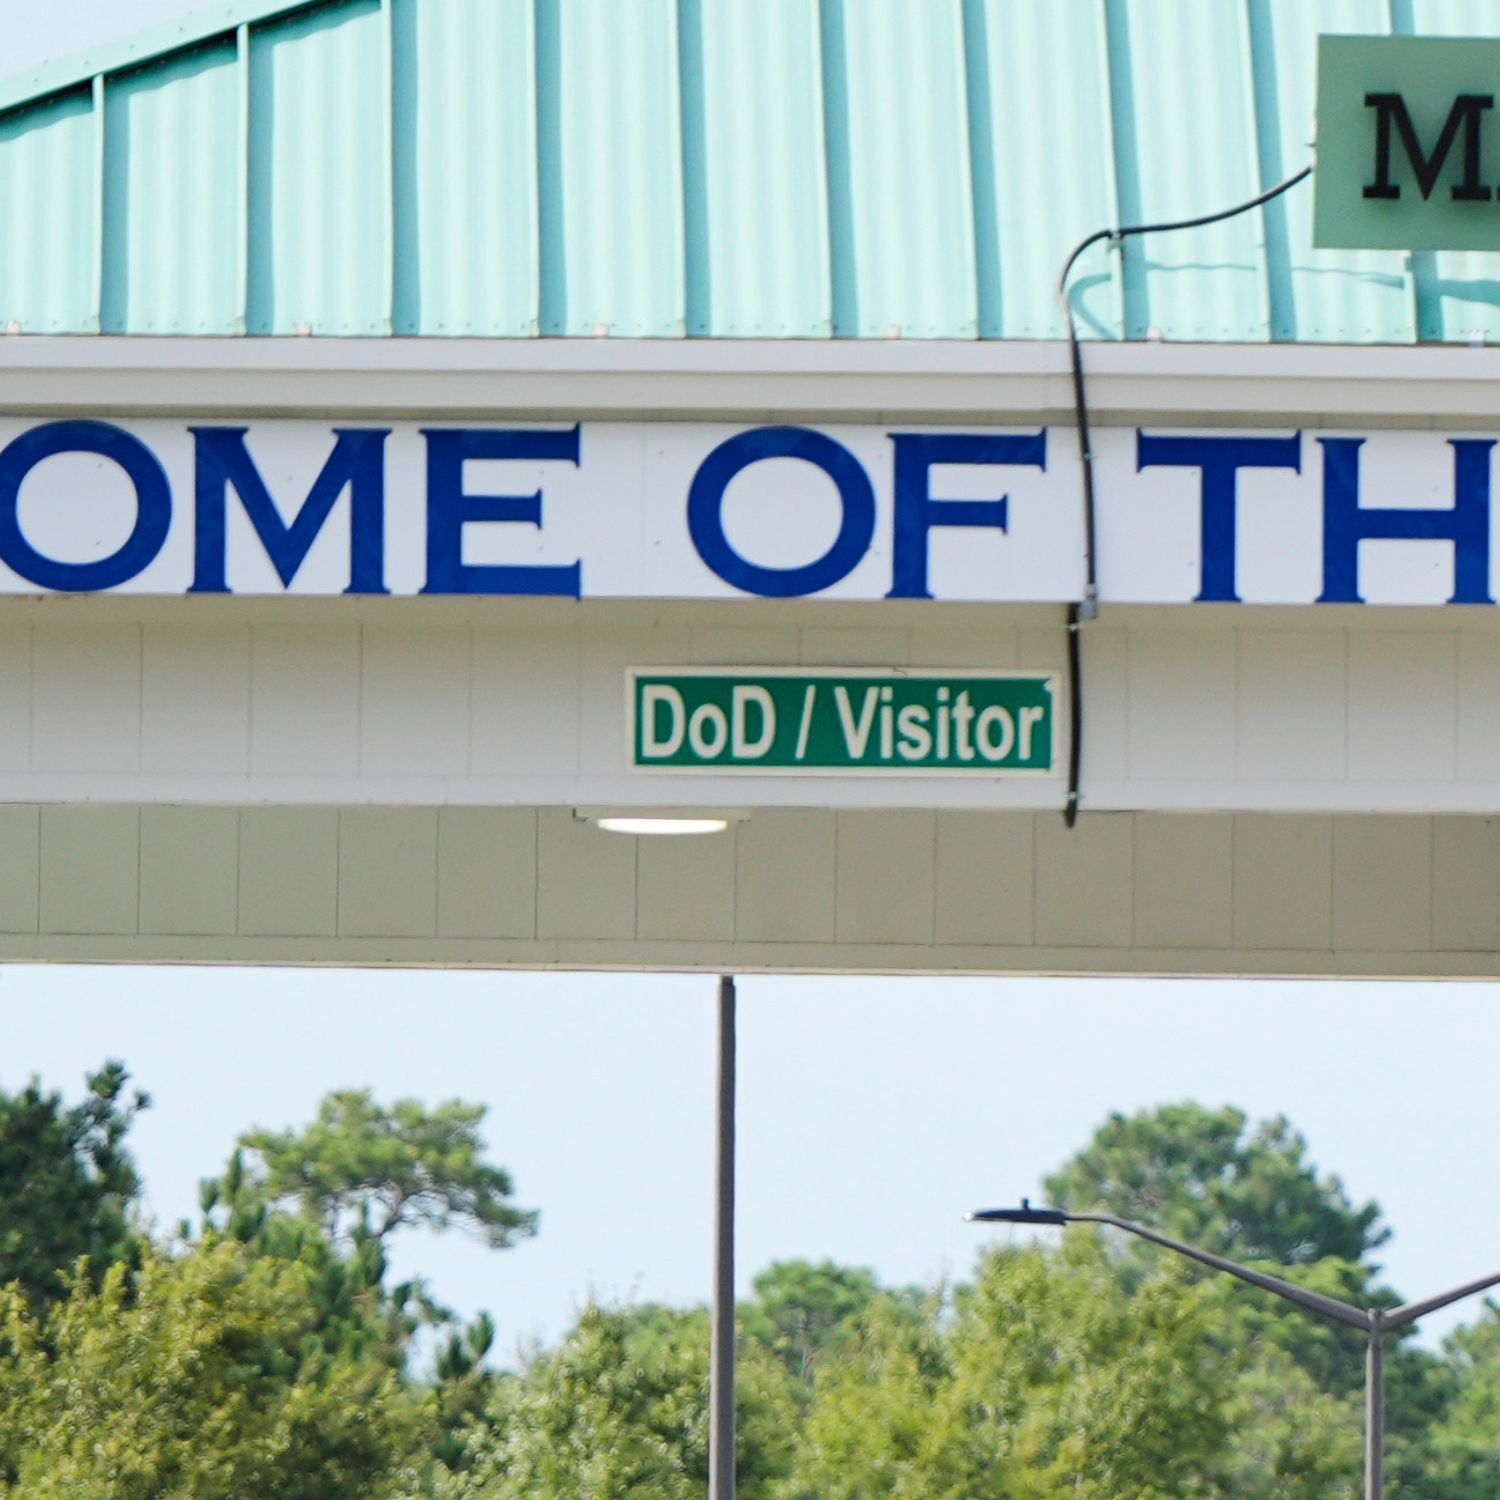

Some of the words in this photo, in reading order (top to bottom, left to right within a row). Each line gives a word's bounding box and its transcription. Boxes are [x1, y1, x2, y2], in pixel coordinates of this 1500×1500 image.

[0, 419, 583, 602] OME
[686, 425, 1049, 600] OF
[640, 685, 777, 760] DoD
[795, 685, 816, 762] /
[833, 686, 1045, 764] Visitor
